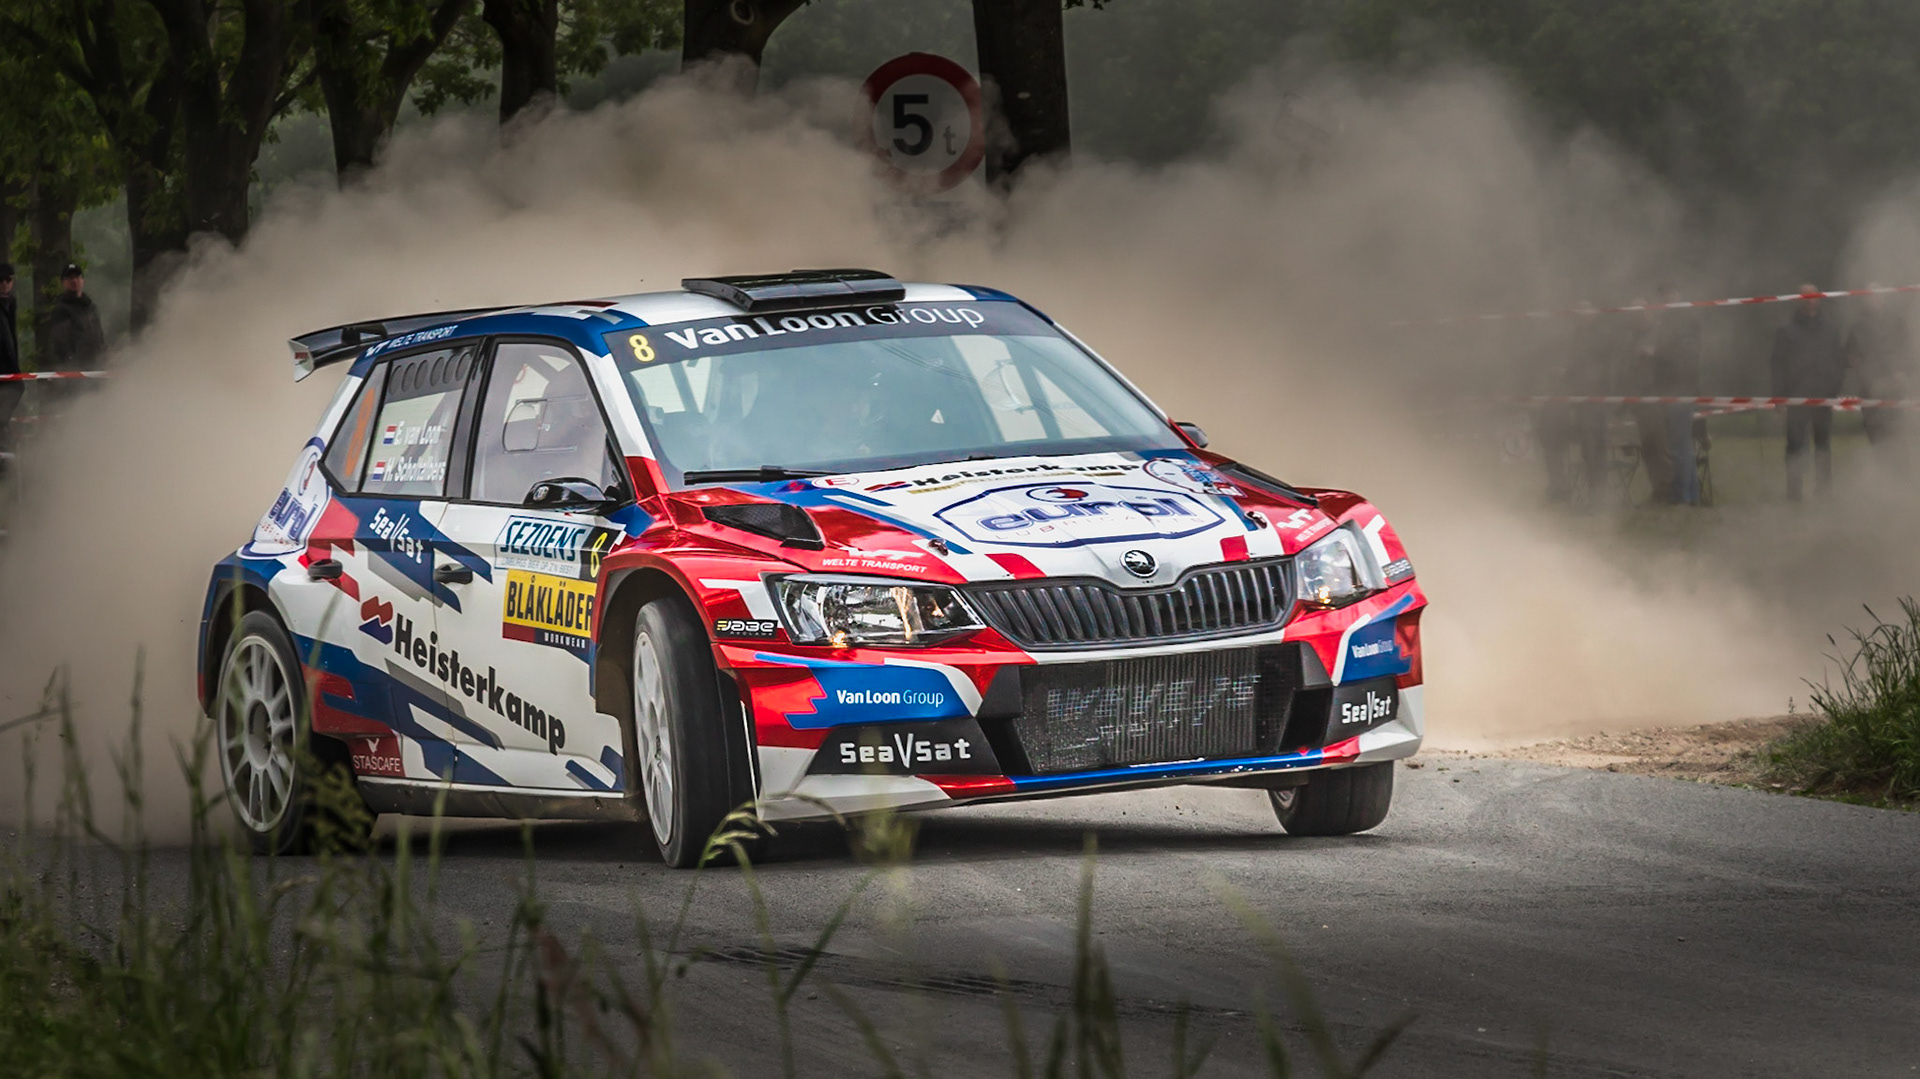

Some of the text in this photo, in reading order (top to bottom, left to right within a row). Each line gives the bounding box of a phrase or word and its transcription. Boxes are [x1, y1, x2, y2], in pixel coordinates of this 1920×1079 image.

[893, 94, 957, 156] 5 t
[628, 334, 656, 362] 8
[866, 305, 985, 329] Group
[500, 521, 608, 579] SEZOENS 8
[822, 558, 928, 573] WELTE TRANSPORT
[506, 575, 596, 632] BLÅKLÄDER
[543, 632, 586, 649] WORKWEAR
[395, 613, 566, 757] Heisterkamp
[903, 689, 945, 708] Group
[352, 755, 401, 772] STASCAFE
